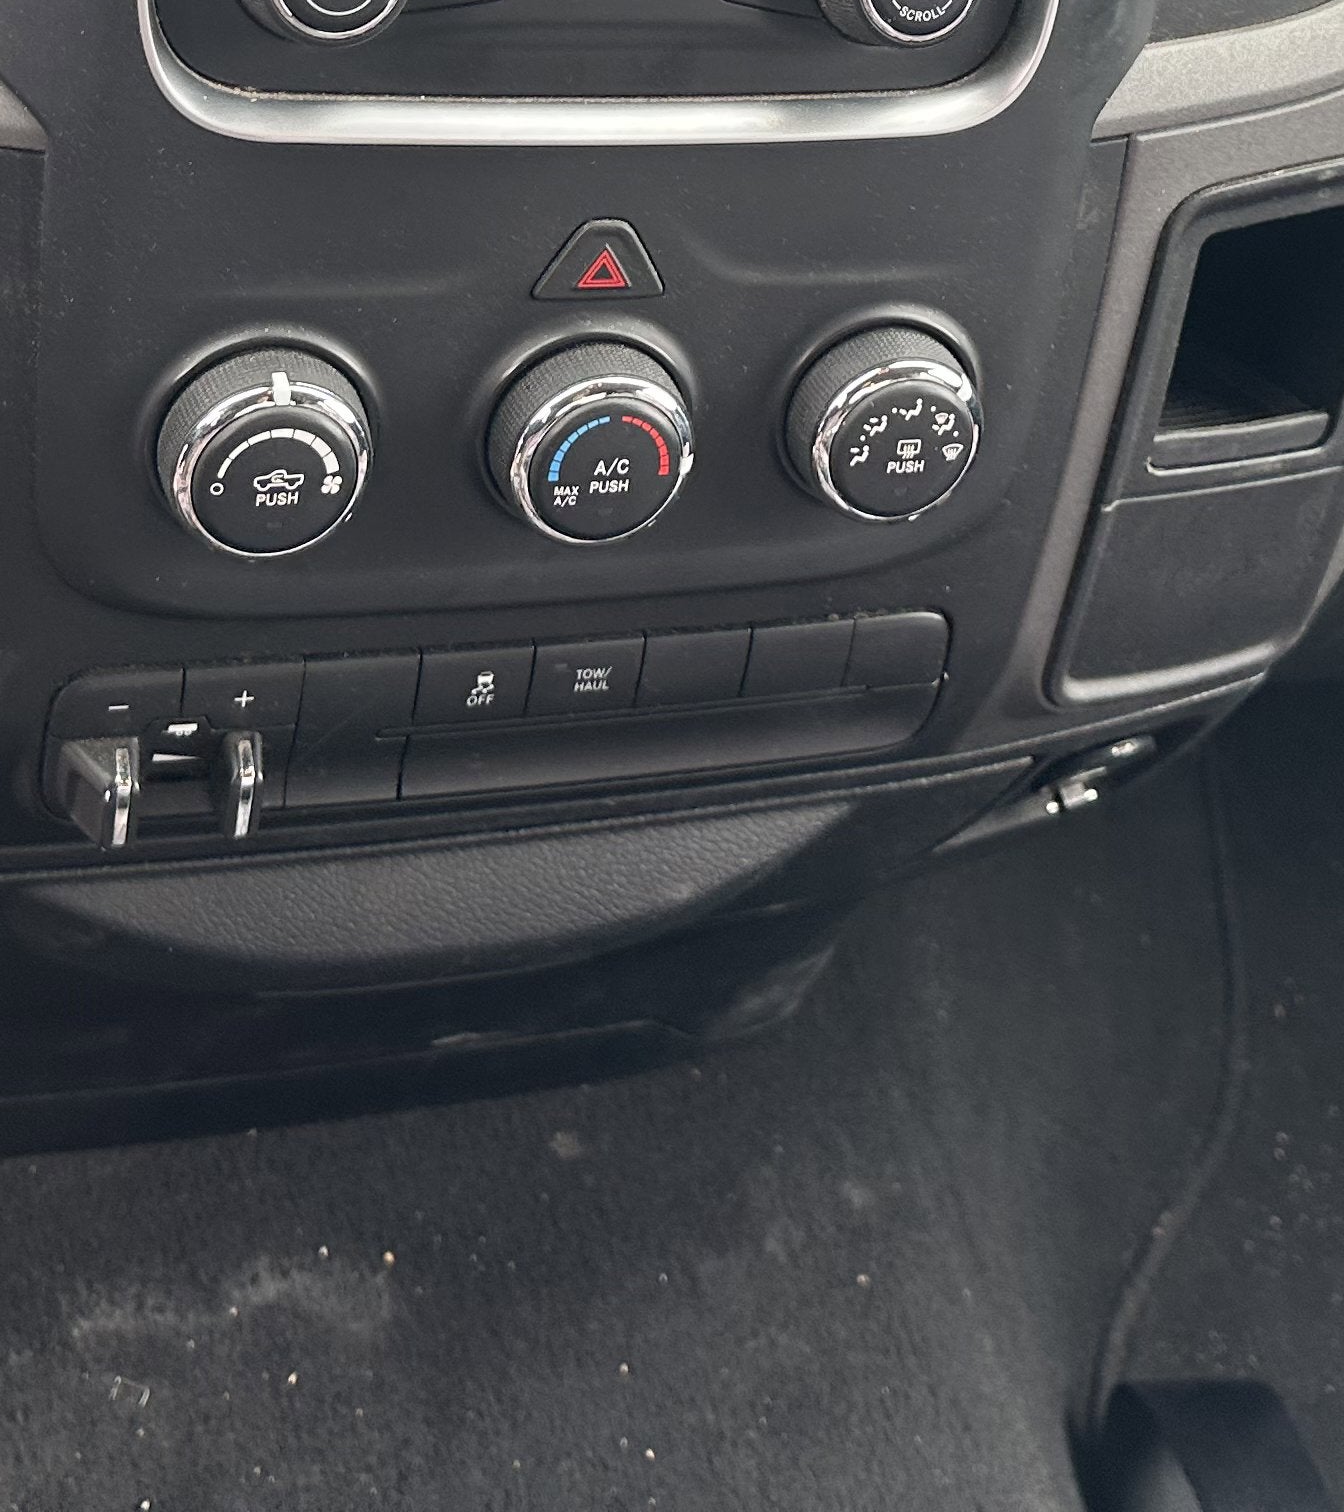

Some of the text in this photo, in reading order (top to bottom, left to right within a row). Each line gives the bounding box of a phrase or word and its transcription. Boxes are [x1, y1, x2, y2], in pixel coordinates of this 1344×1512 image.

[898, 5, 946, 23] SCROLL
[594, 457, 630, 476] A/C
[886, 459, 925, 474] PUSH
[553, 486, 580, 496] MAX
[589, 478, 630, 494] PUSH
[255, 491, 299, 507] PUSH
[553, 495, 577, 507] A/C
[576, 666, 613, 680] TOW/
[574, 679, 610, 693] HAUL
[466, 693, 495, 707] OFF
